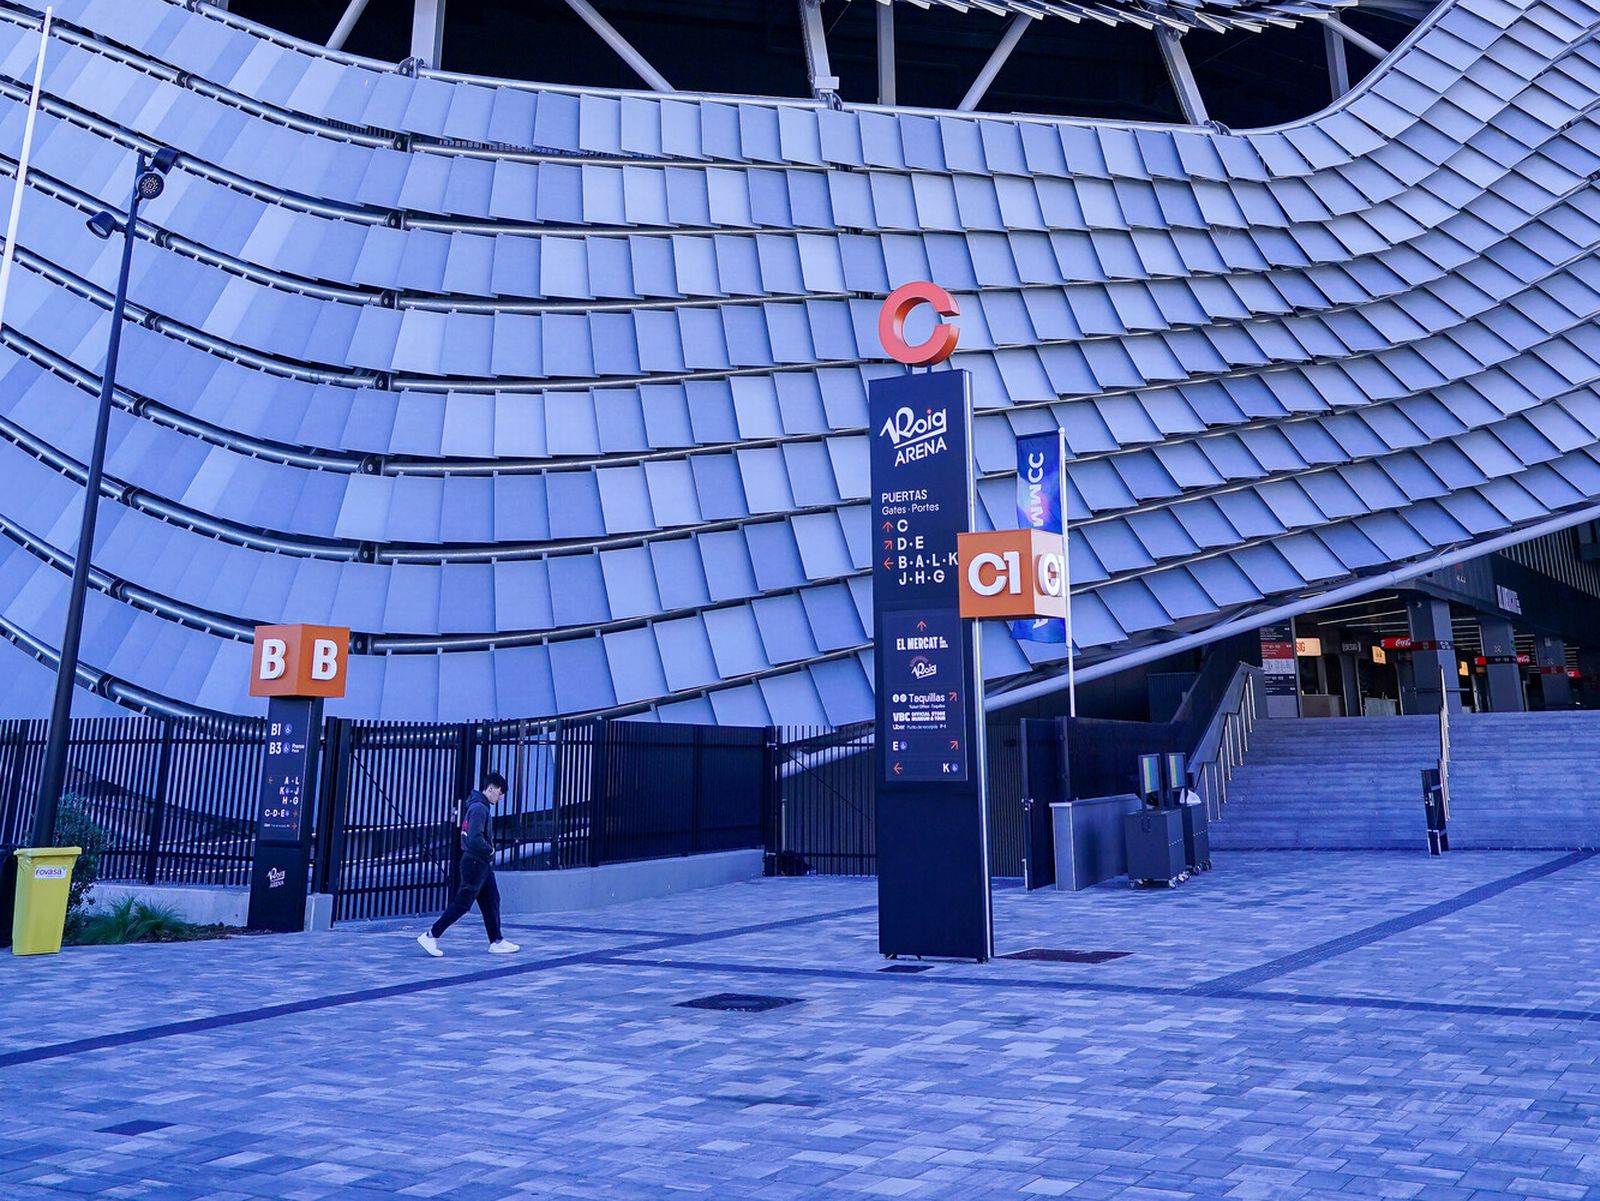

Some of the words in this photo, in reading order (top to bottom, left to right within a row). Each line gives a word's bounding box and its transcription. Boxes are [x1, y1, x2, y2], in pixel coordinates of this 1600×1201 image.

[878, 281, 961, 365] C
[880, 406, 947, 450] Roig
[894, 436, 947, 467] ARENA
[881, 489, 928, 503] PUERTAS
[881, 506, 907, 516] Gates
[911, 503, 940, 513] Portes
[897, 519, 909, 533] C
[968, 551, 1022, 596] C1
[896, 638, 906, 651] EL
[907, 636, 938, 650] MERCAT
[259, 639, 287, 680] B
[312, 639, 339, 680] B
[908, 693, 946, 704] Taquillas
[892, 712, 911, 722] VBC
[271, 723, 282, 736] B1
[269, 742, 282, 755] B3
[892, 741, 899, 751] E
[942, 763, 950, 773] K
